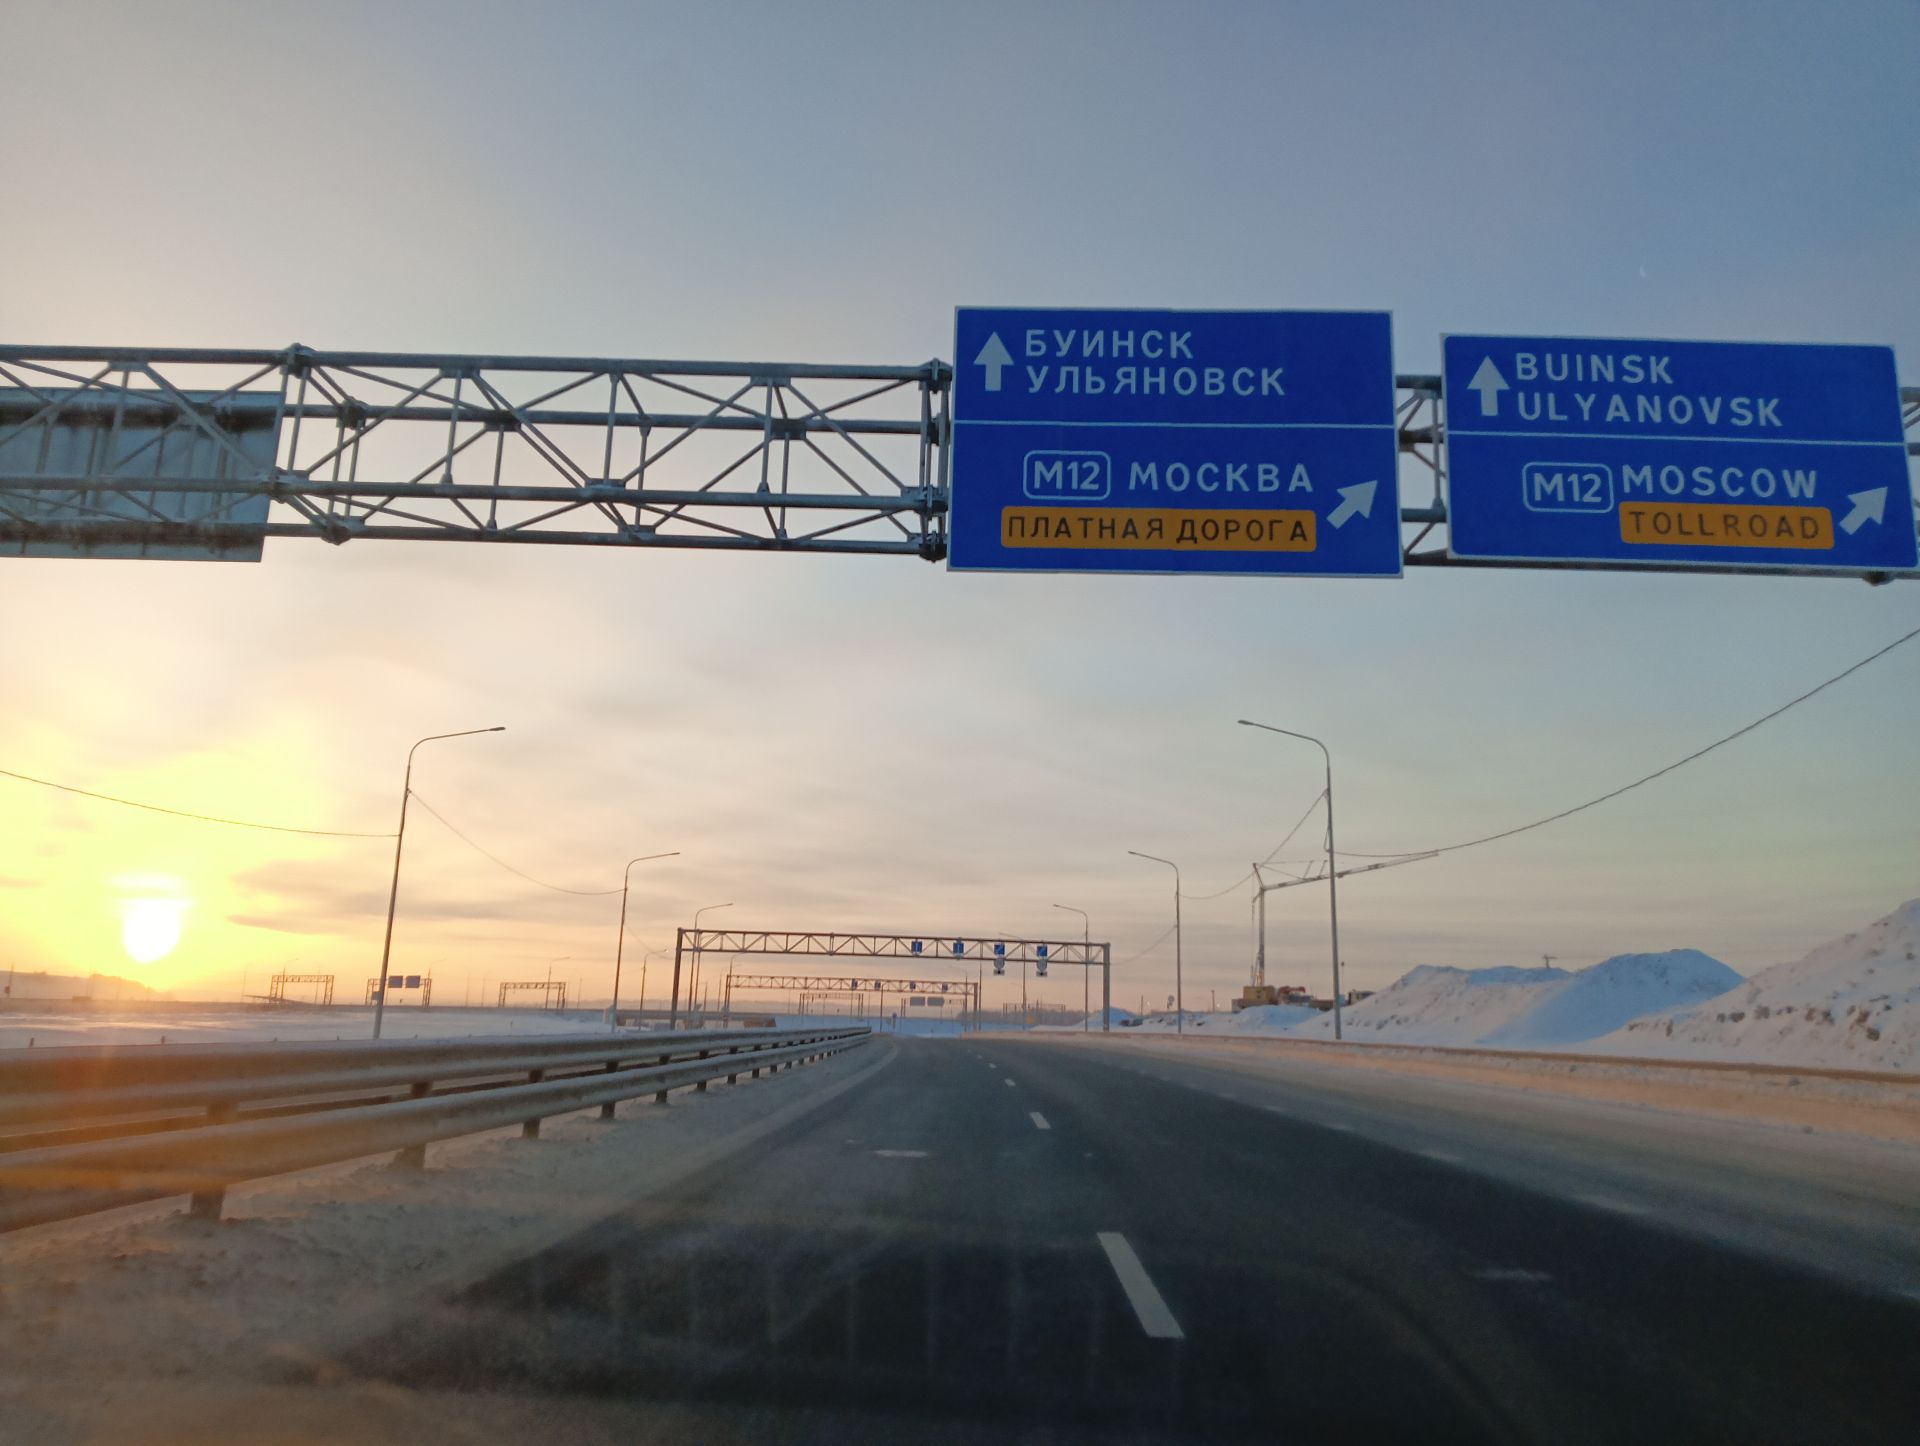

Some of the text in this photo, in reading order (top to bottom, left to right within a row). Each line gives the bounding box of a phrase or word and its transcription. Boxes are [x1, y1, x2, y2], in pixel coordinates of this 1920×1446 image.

[1025, 329, 1194, 360] БУИНСК
[1026, 365, 1285, 396] УЛЬЯНОВСК
[1515, 352, 1674, 384] BUINSK
[1517, 392, 1783, 427] ULYANOVSK
[1033, 460, 1314, 493] М12 МОСКВА
[1532, 464, 1818, 504] M12 MOSCOW
[1008, 515, 1308, 545] ПЛАТНАЯ ДОРОГА
